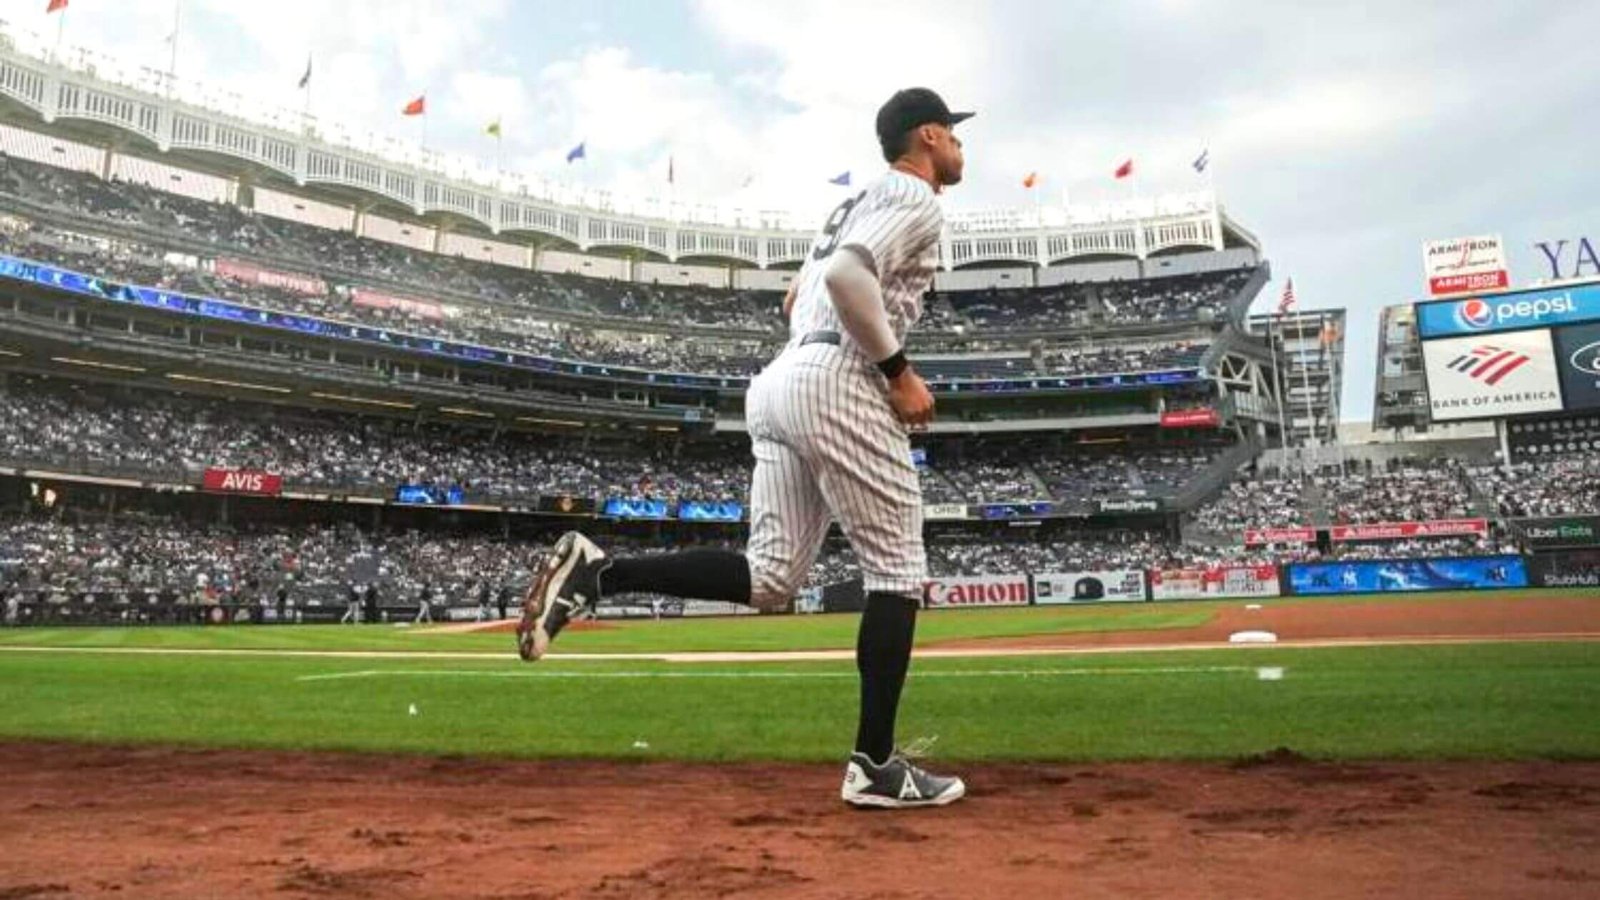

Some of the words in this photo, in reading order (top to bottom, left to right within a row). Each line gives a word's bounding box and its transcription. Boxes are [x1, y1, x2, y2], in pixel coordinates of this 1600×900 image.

[1497, 292, 1577, 322] pepsi
[1433, 397, 1469, 409] BANK
[1473, 395, 1490, 406] OF
[1494, 391, 1557, 405] AMERICA
[221, 472, 262, 491] AVIS
[1526, 527, 1557, 538] Uber
[1560, 525, 1593, 537] Eats
[923, 580, 1027, 605] Canon
